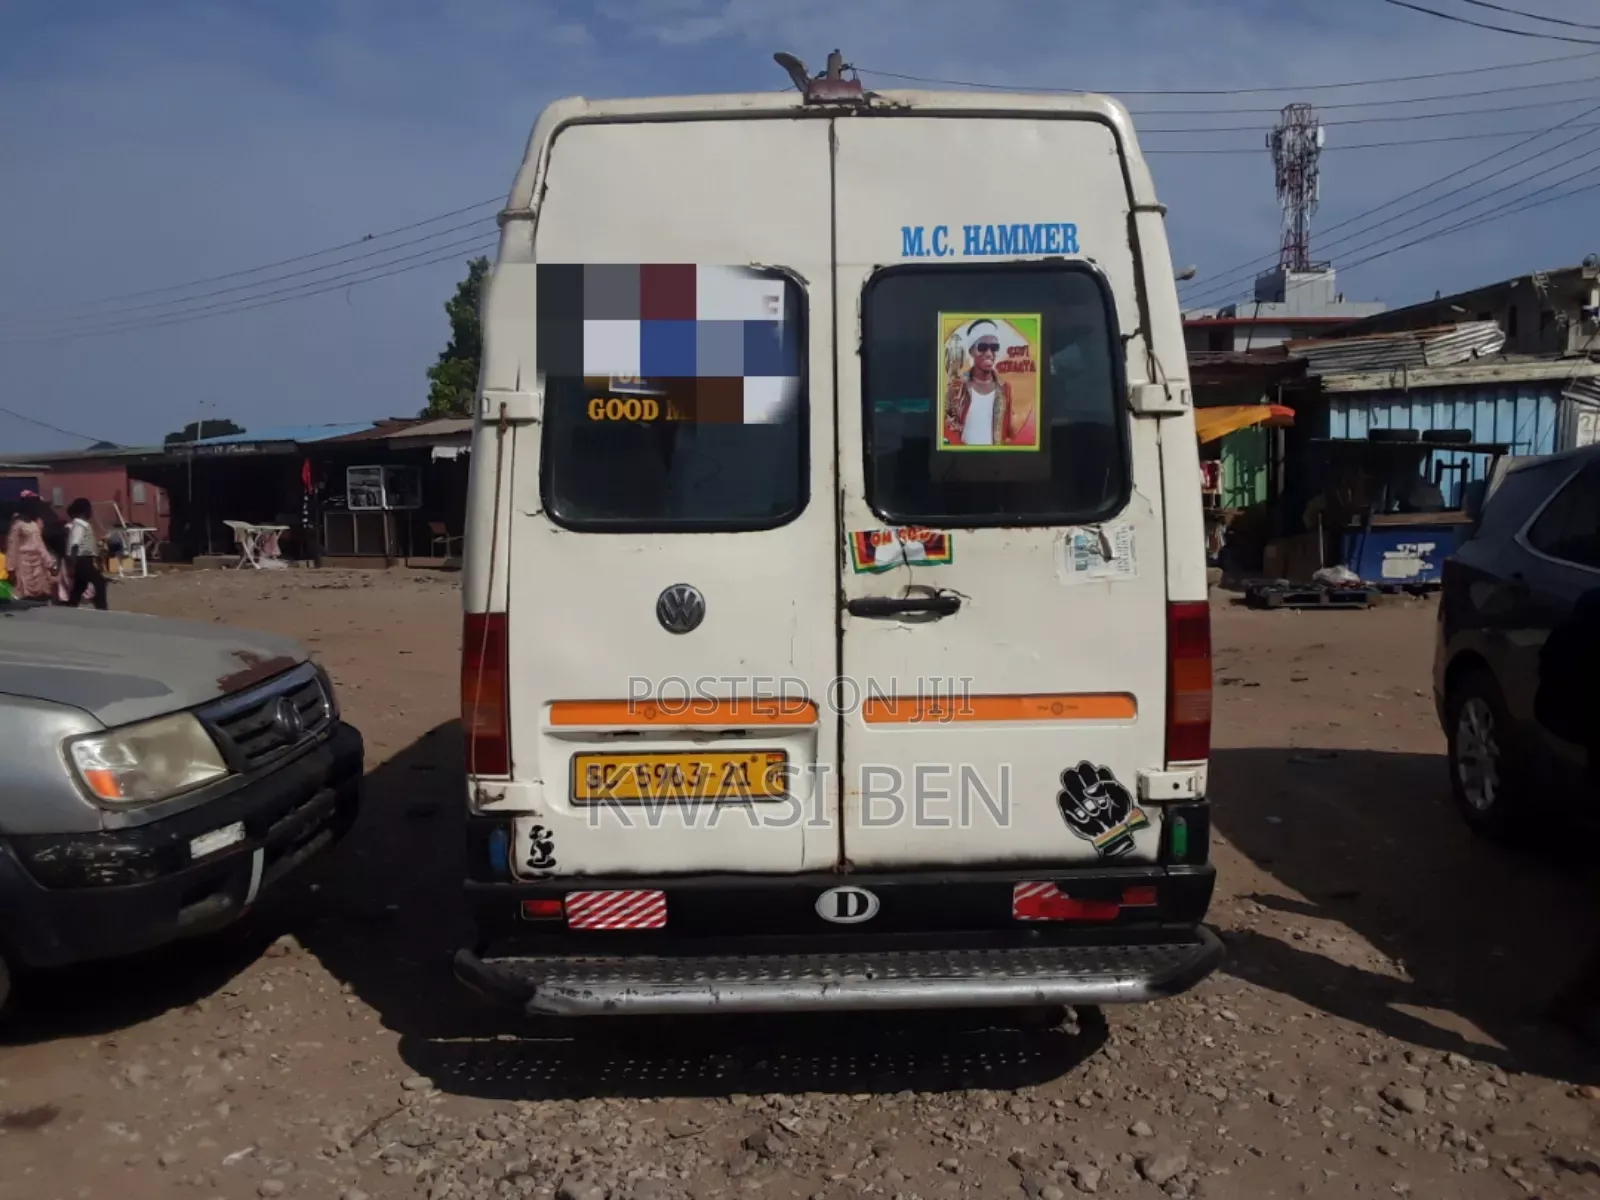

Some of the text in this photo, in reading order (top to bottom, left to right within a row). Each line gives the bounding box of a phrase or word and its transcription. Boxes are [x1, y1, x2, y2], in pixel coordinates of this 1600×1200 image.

[900, 222, 1081, 257] M.C. HAMMER
[587, 398, 660, 421] GOOD
[833, 891, 869, 918] D
